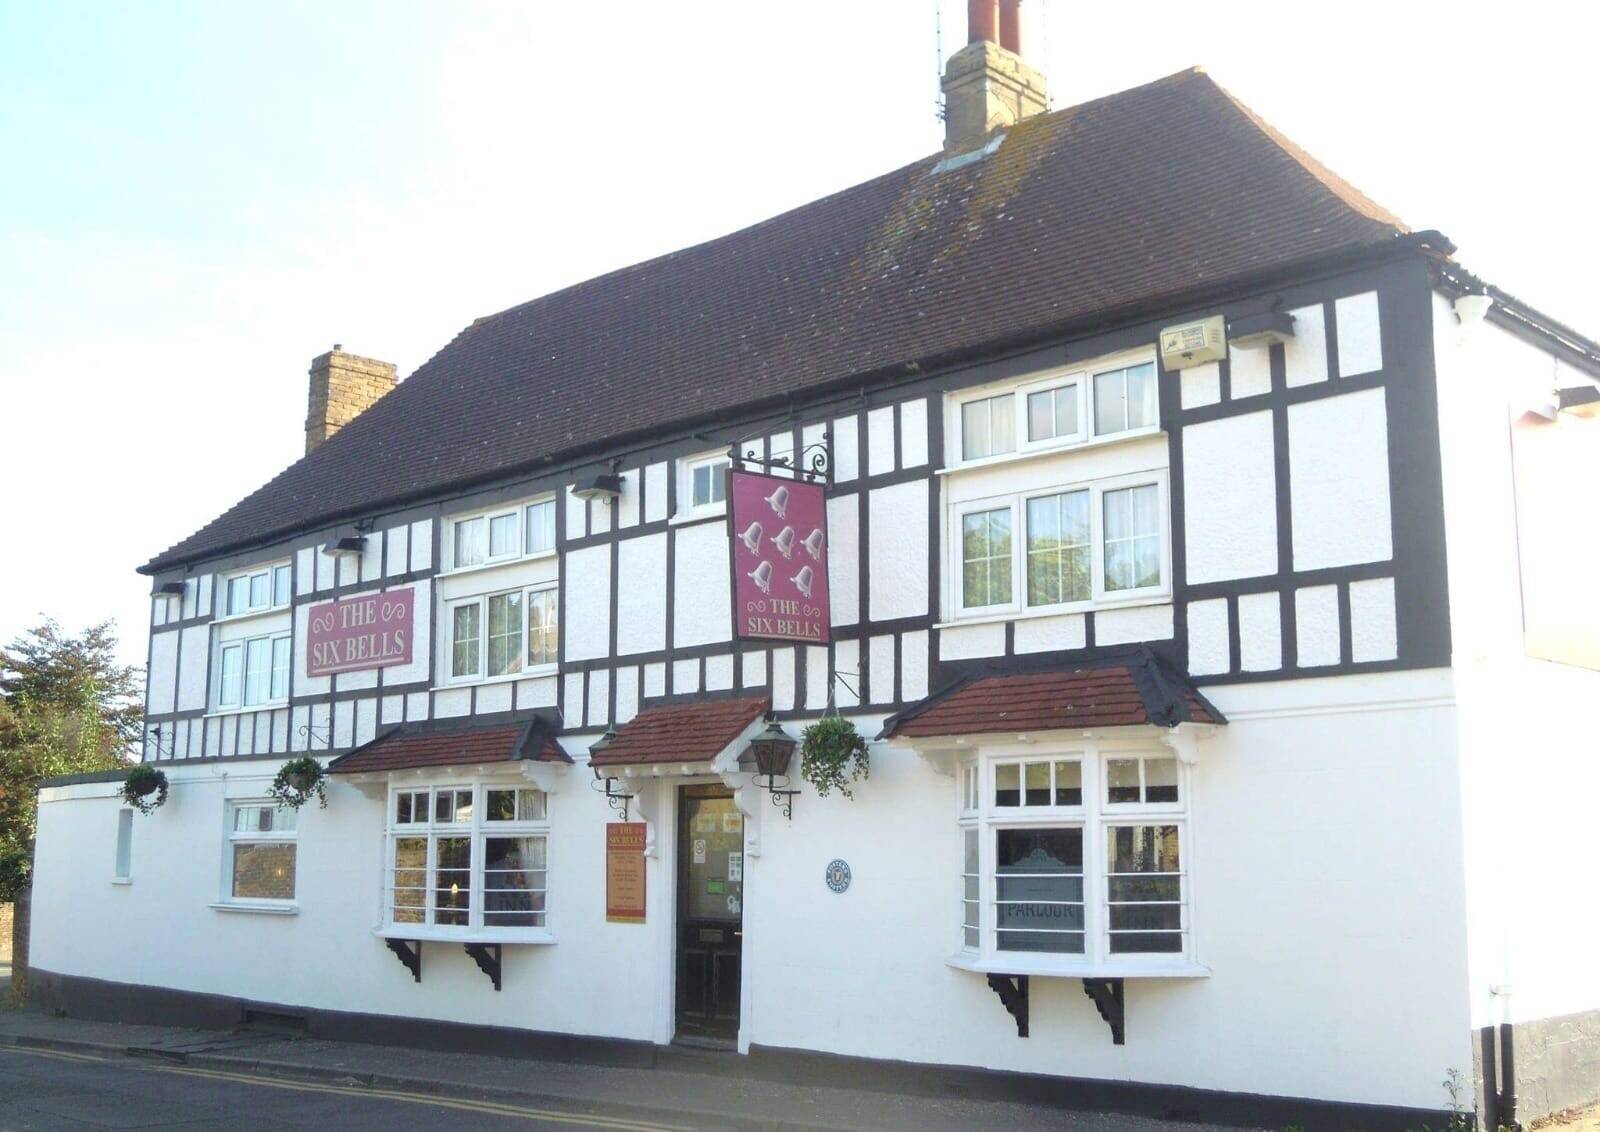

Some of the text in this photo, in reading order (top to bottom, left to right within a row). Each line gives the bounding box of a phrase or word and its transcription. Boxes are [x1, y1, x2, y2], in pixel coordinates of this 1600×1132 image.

[340, 600, 377, 628] THE
[770, 599, 800, 615] THE
[748, 617, 820, 637] SIX BELLS
[313, 629, 405, 667] SIX BELLS
[1007, 903, 1074, 918] PARLOUR
